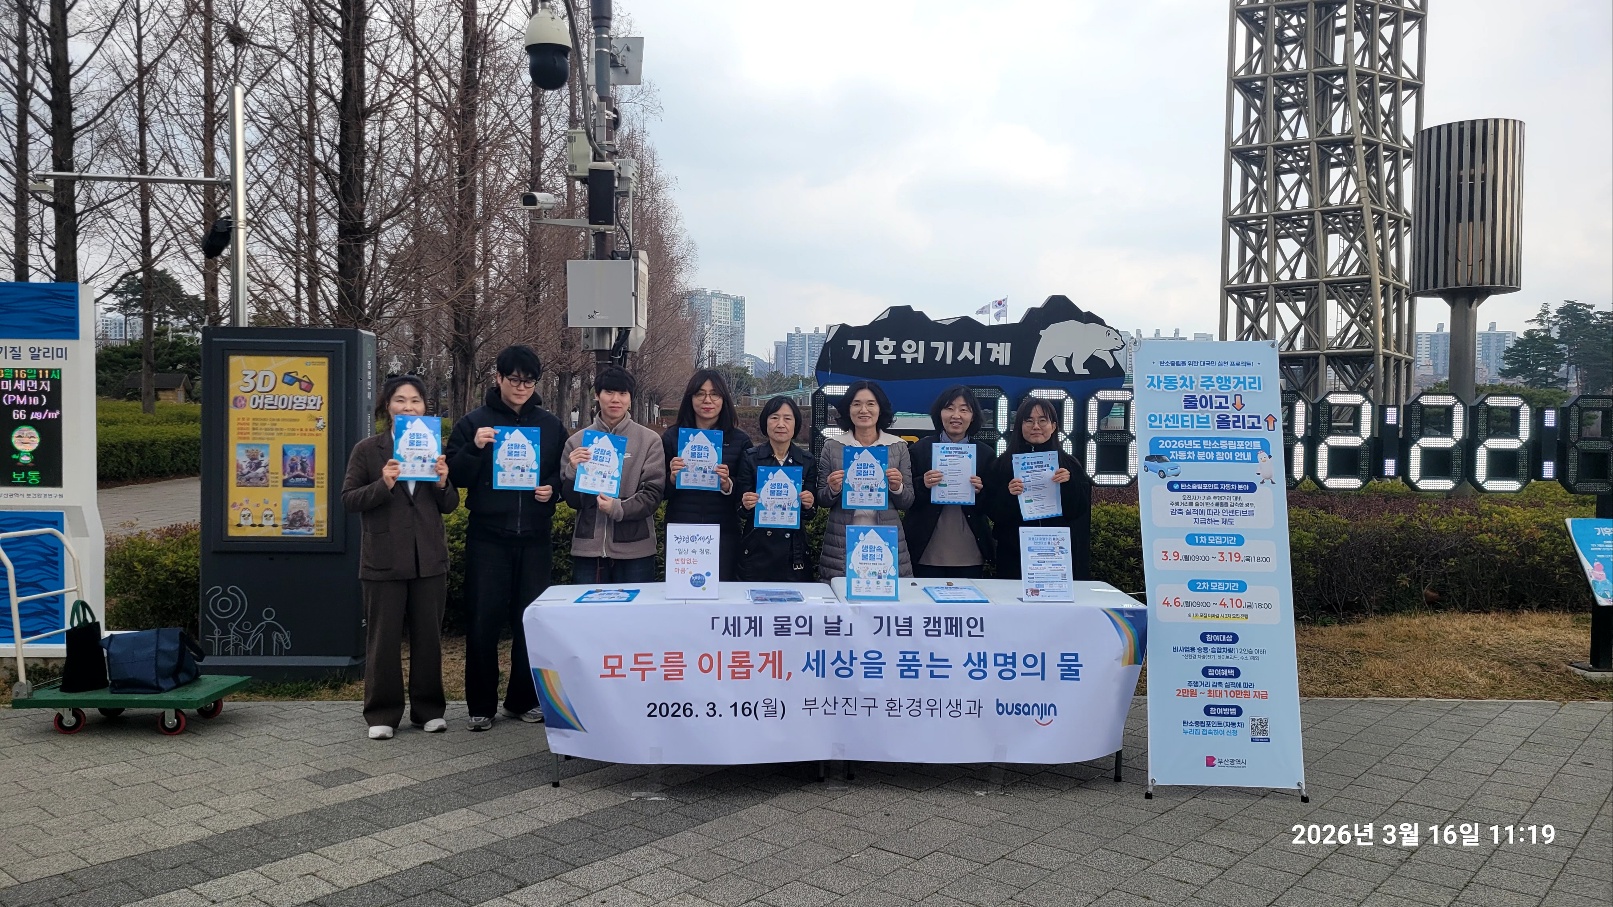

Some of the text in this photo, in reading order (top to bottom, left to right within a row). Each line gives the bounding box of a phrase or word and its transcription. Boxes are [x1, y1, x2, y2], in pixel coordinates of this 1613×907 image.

[28, 346, 68, 361] 알리미
[847, 337, 1012, 366] 기후위기시계
[1, 380, 51, 392] 미세먼지
[239, 369, 277, 393] 3D
[1146, 375, 1262, 391] 자동차 주행거리
[249, 394, 323, 411] 어린이영화
[1182, 394, 1230, 410] 줄이고
[12, 410, 26, 420] 66
[1147, 413, 1262, 430] 인센티브 올리고
[1158, 440, 1262, 450] 2026년도 탄소중립포인트
[1170, 451, 1252, 461] 자동차 분야 참여 안내
[11, 471, 41, 484] 보통
[1194, 536, 1236, 544] 1차 모집기간
[1196, 582, 1239, 590] 2차 모집기간
[772, 614, 813, 637] 물의
[872, 616, 913, 638] 기념
[922, 616, 985, 638] 캠페인
[600, 649, 1084, 682] 모두를 이롭게, 세상을 품는 생명의 물
[1176, 689, 1198, 698] 2만원
[1207, 690, 1222, 698] 최대
[1224, 690, 1251, 699] 10만원
[1253, 690, 1268, 699] 지급
[646, 696, 1058, 720] 2026. 3. 16(월) 부산진구 환경위생과 busanjin
[1218, 758, 1247, 766] 부산광역시
